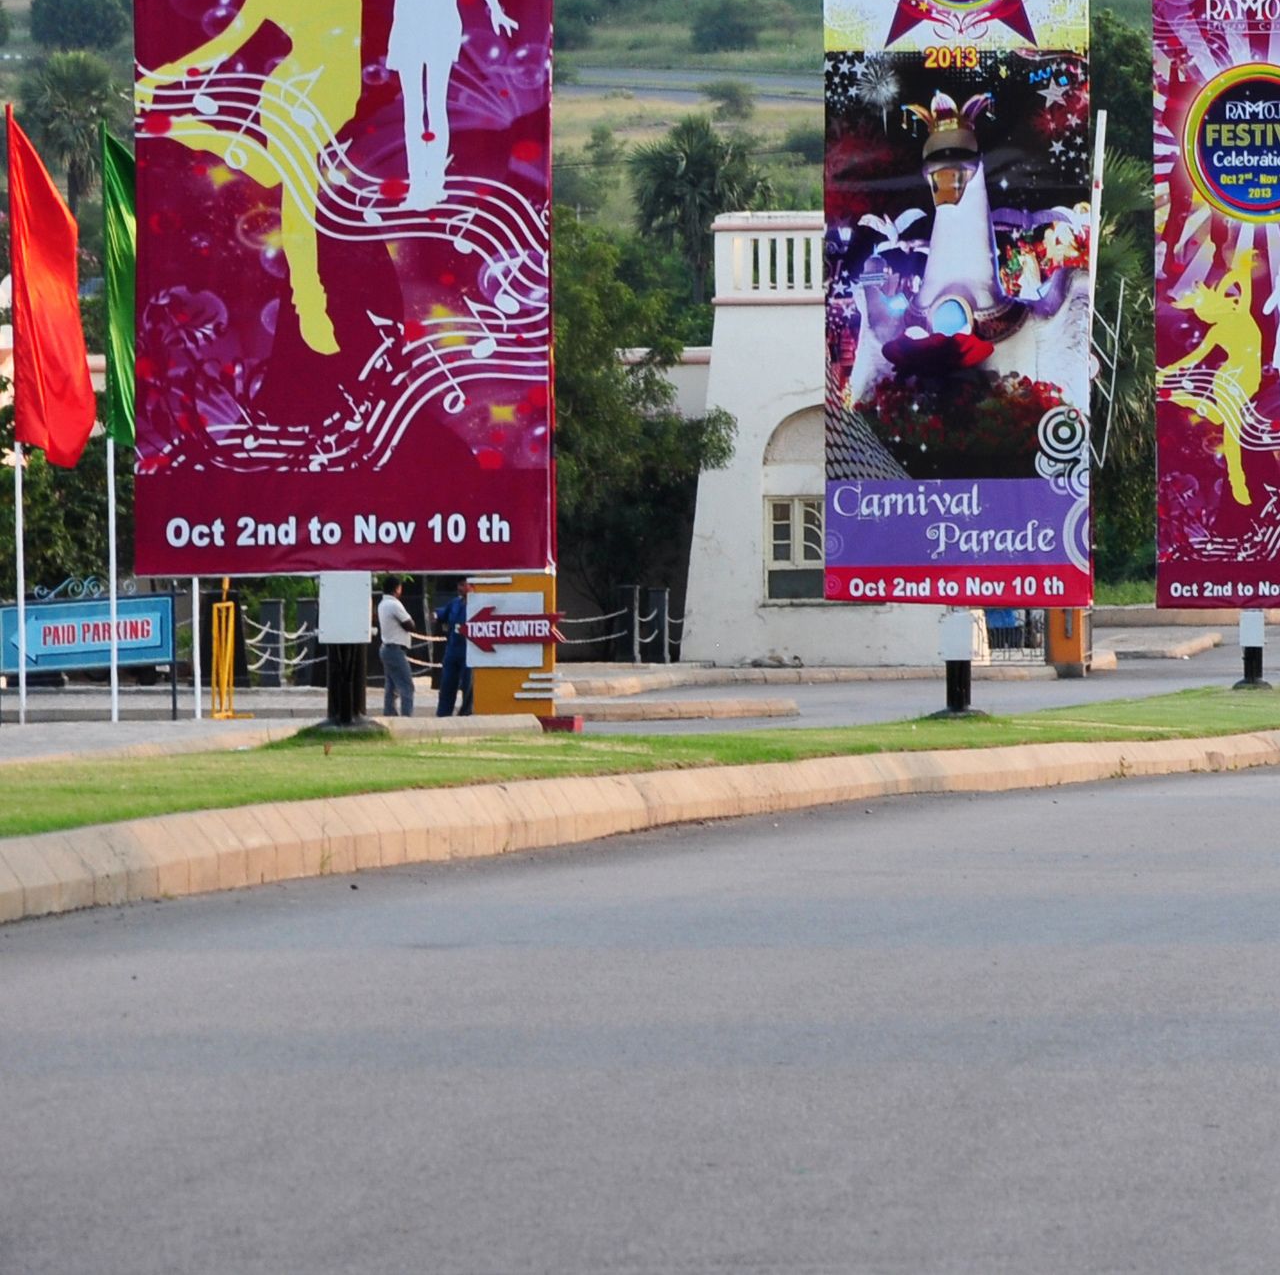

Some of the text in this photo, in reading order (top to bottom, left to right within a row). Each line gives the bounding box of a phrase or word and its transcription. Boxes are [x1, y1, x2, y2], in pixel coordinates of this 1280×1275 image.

[925, 46, 978, 69] 2013
[1220, 173, 1236, 184] Oct
[1259, 174, 1277, 184] Nov
[1248, 188, 1272, 198] 2013
[833, 482, 981, 519] Carnival
[166, 512, 511, 548] Oct 2nd to Nov 10 th
[926, 520, 1055, 559] Parade
[849, 576, 1064, 597] Oct 2nd to Nov 10 th
[1170, 582, 1198, 597] Oct
[1203, 581, 1232, 597] 2nd
[1237, 582, 1254, 596] to
[42, 623, 77, 647] PAID
[465, 619, 550, 638] TICKET COUNTER
